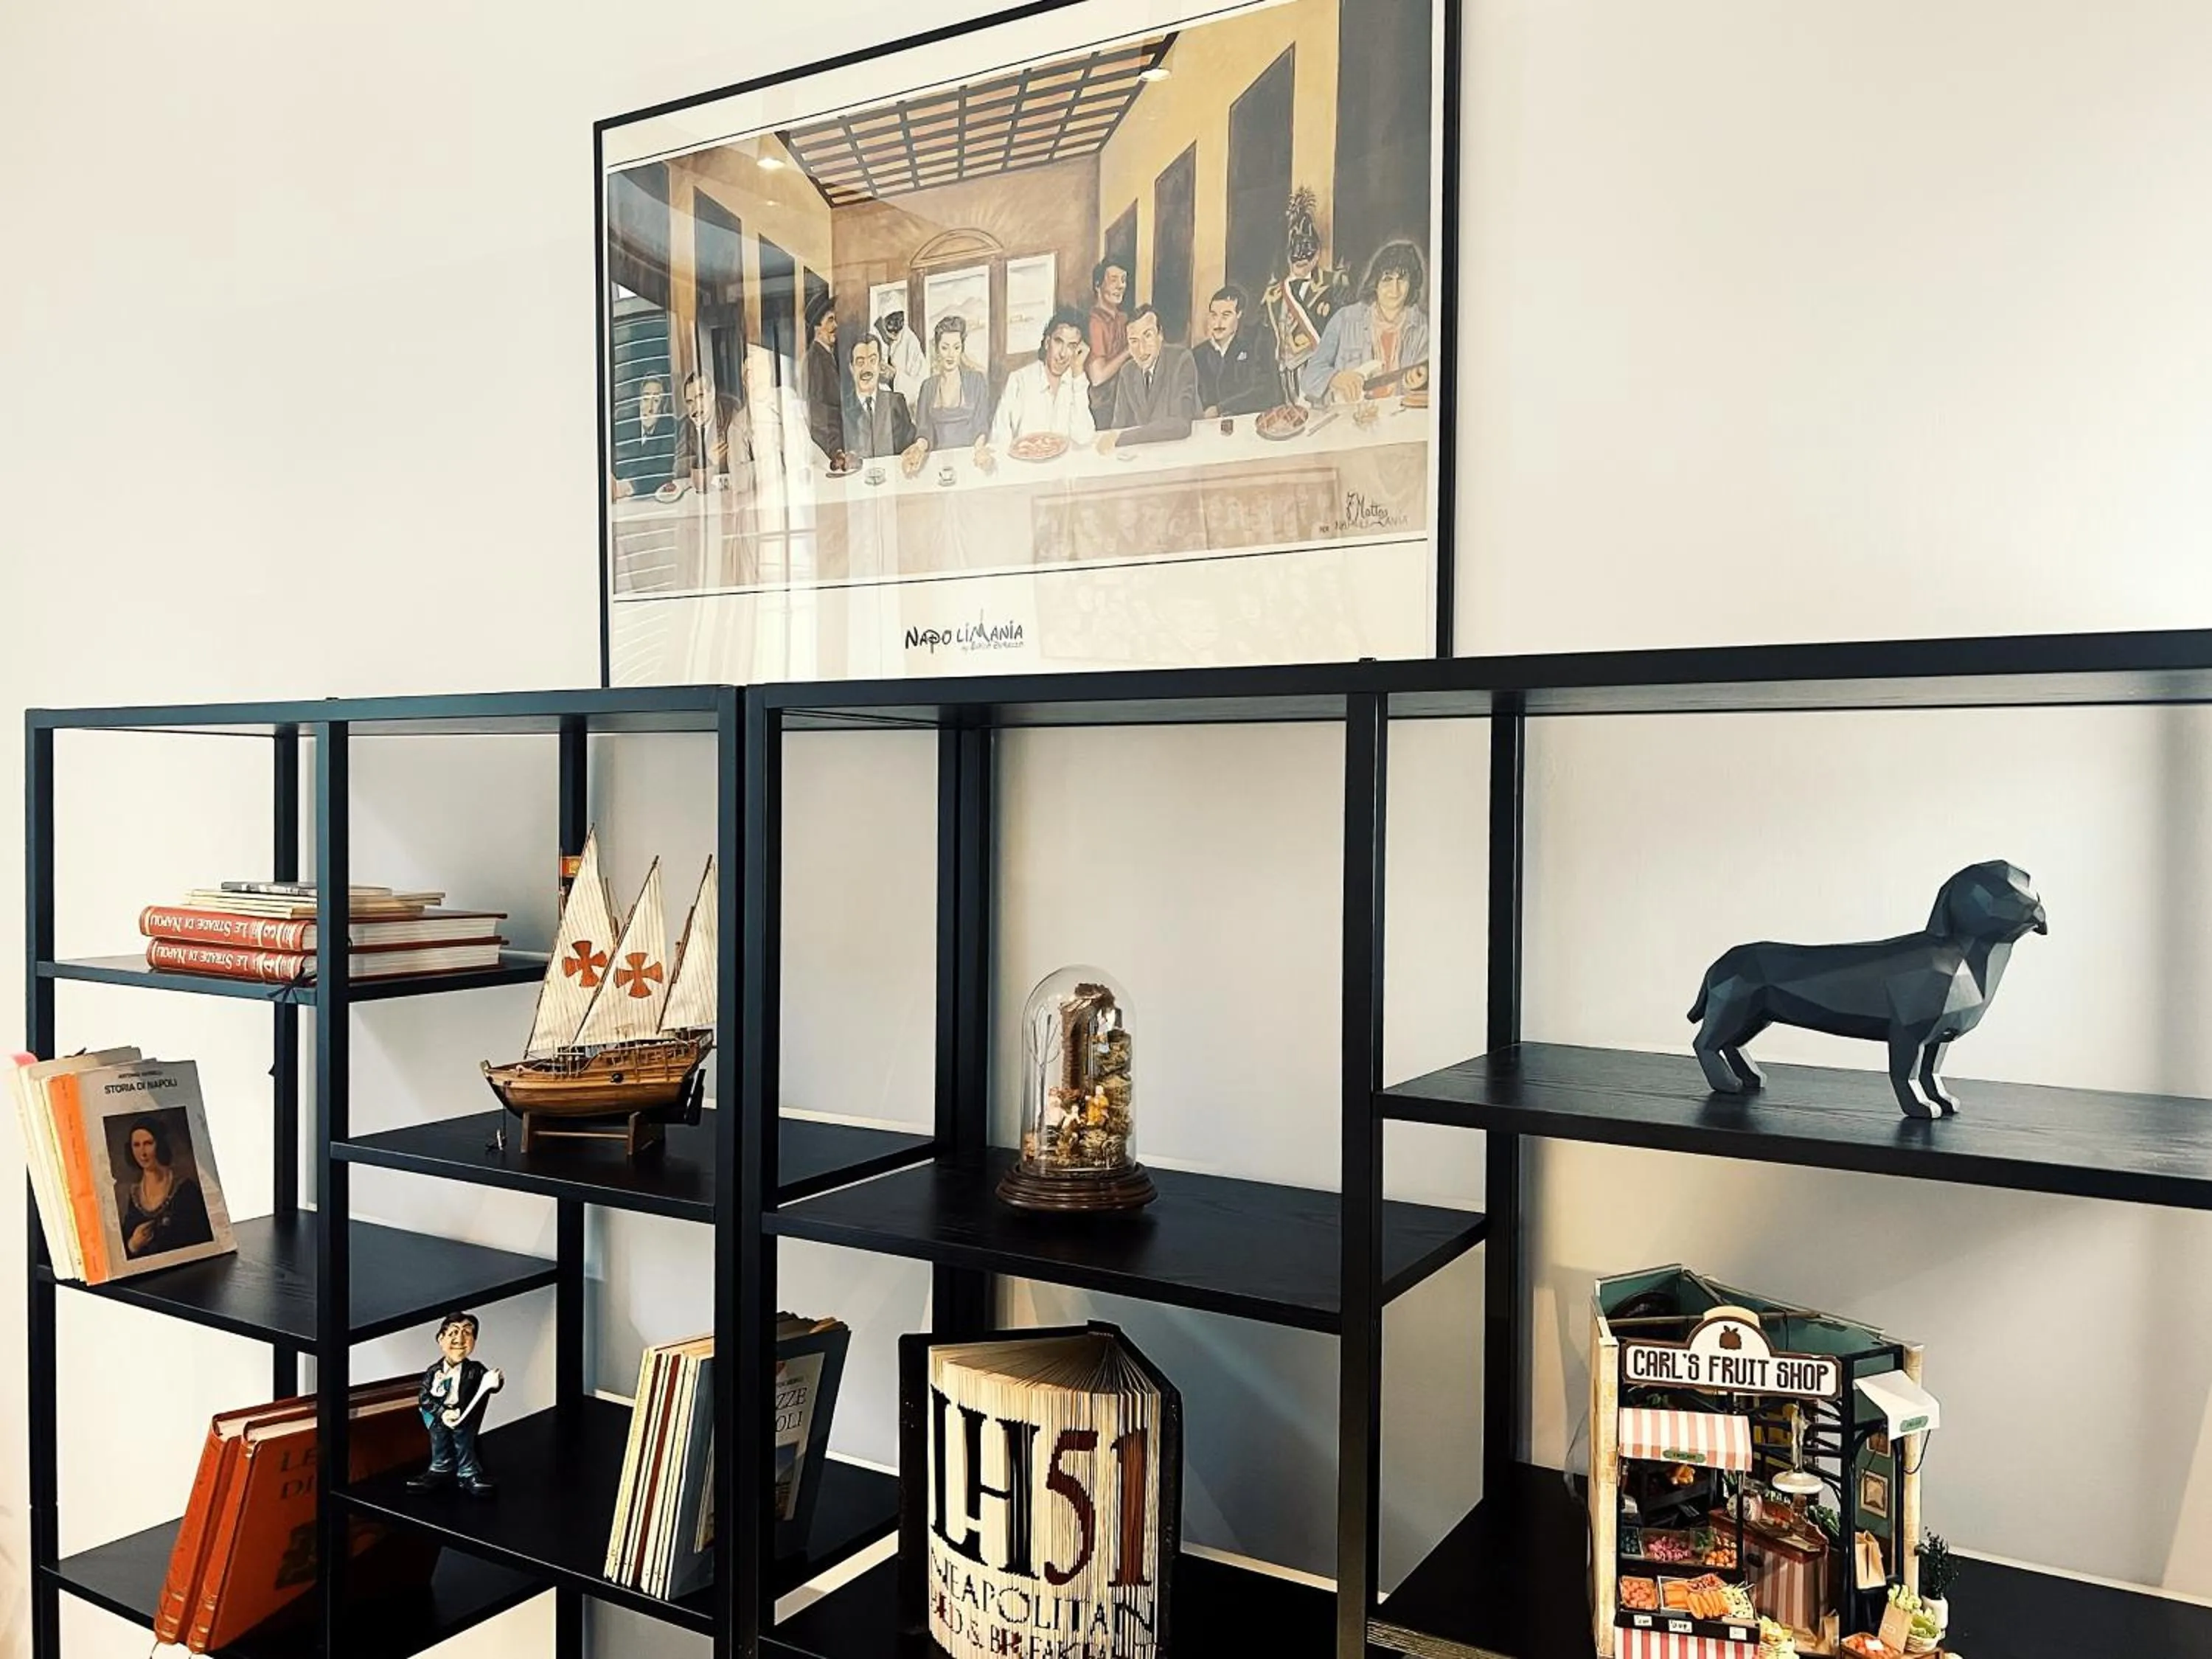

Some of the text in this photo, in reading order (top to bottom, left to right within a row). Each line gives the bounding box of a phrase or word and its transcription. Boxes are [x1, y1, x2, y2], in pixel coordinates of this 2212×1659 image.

[197, 918, 232, 936] STRADE
[199, 950, 233, 970] STRADE
[104, 1078, 177, 1094] STORIA DI NAPOLI
[1633, 1349, 1829, 1391] CARL'S FRUIT SHOP
[931, 1546, 1154, 1637] NEAPOLITAN
